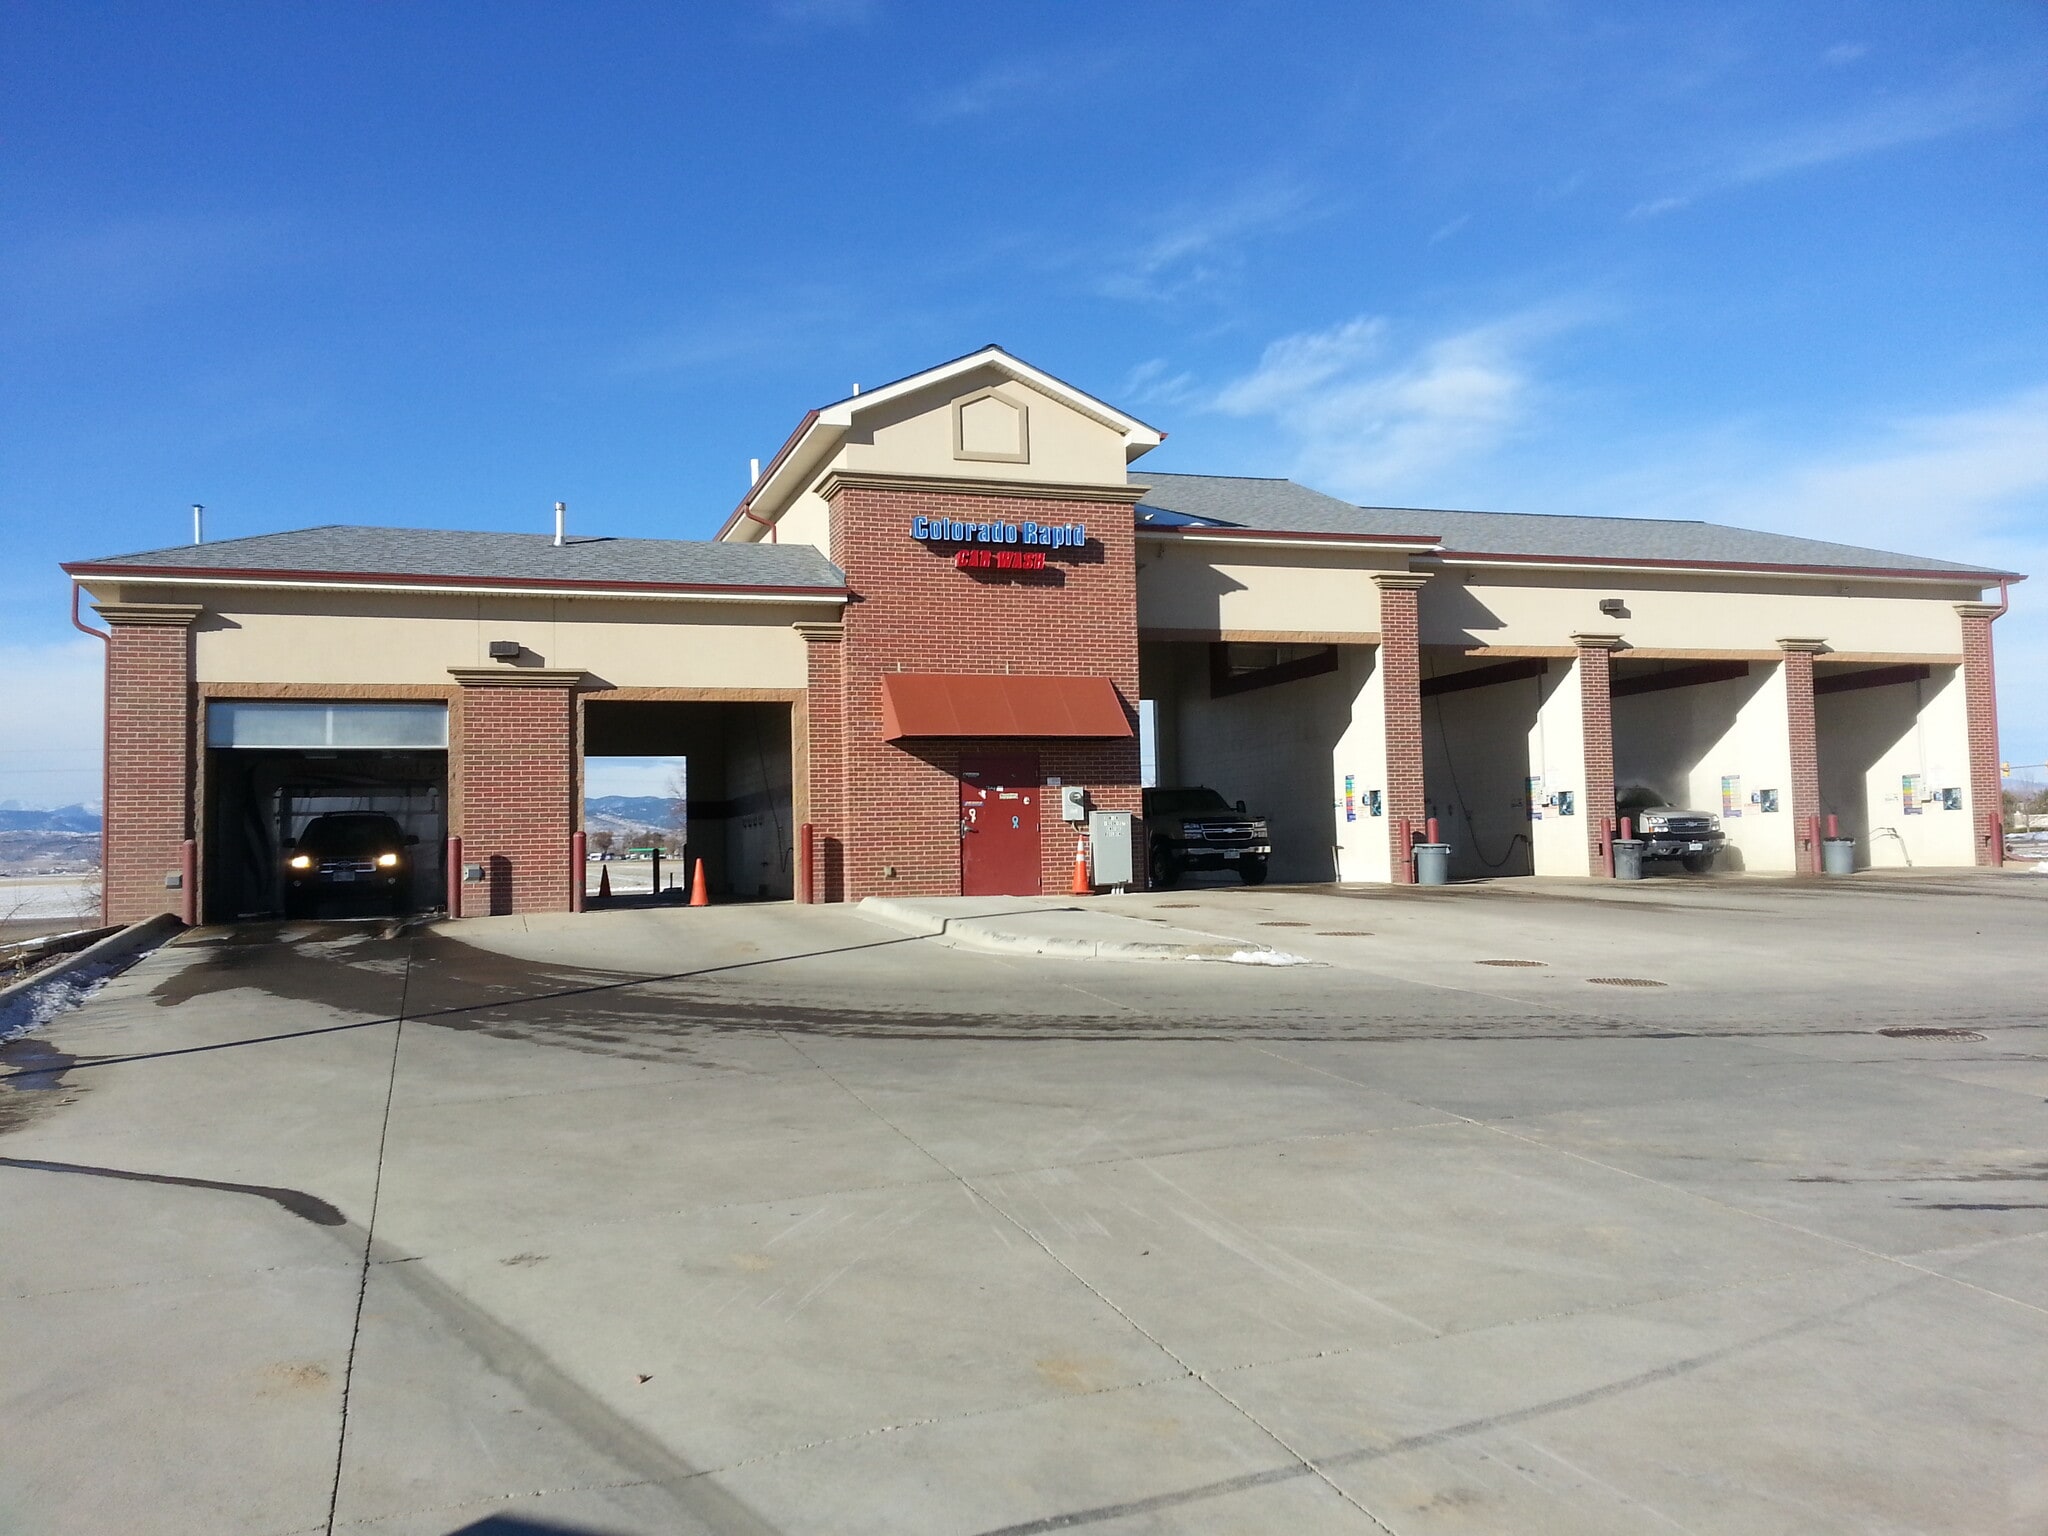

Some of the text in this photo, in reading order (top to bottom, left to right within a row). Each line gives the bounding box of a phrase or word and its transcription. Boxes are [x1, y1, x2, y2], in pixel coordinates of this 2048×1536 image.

[912, 515, 1086, 549] Colorado Rapid
[954, 549, 1047, 570] CAR WASH
